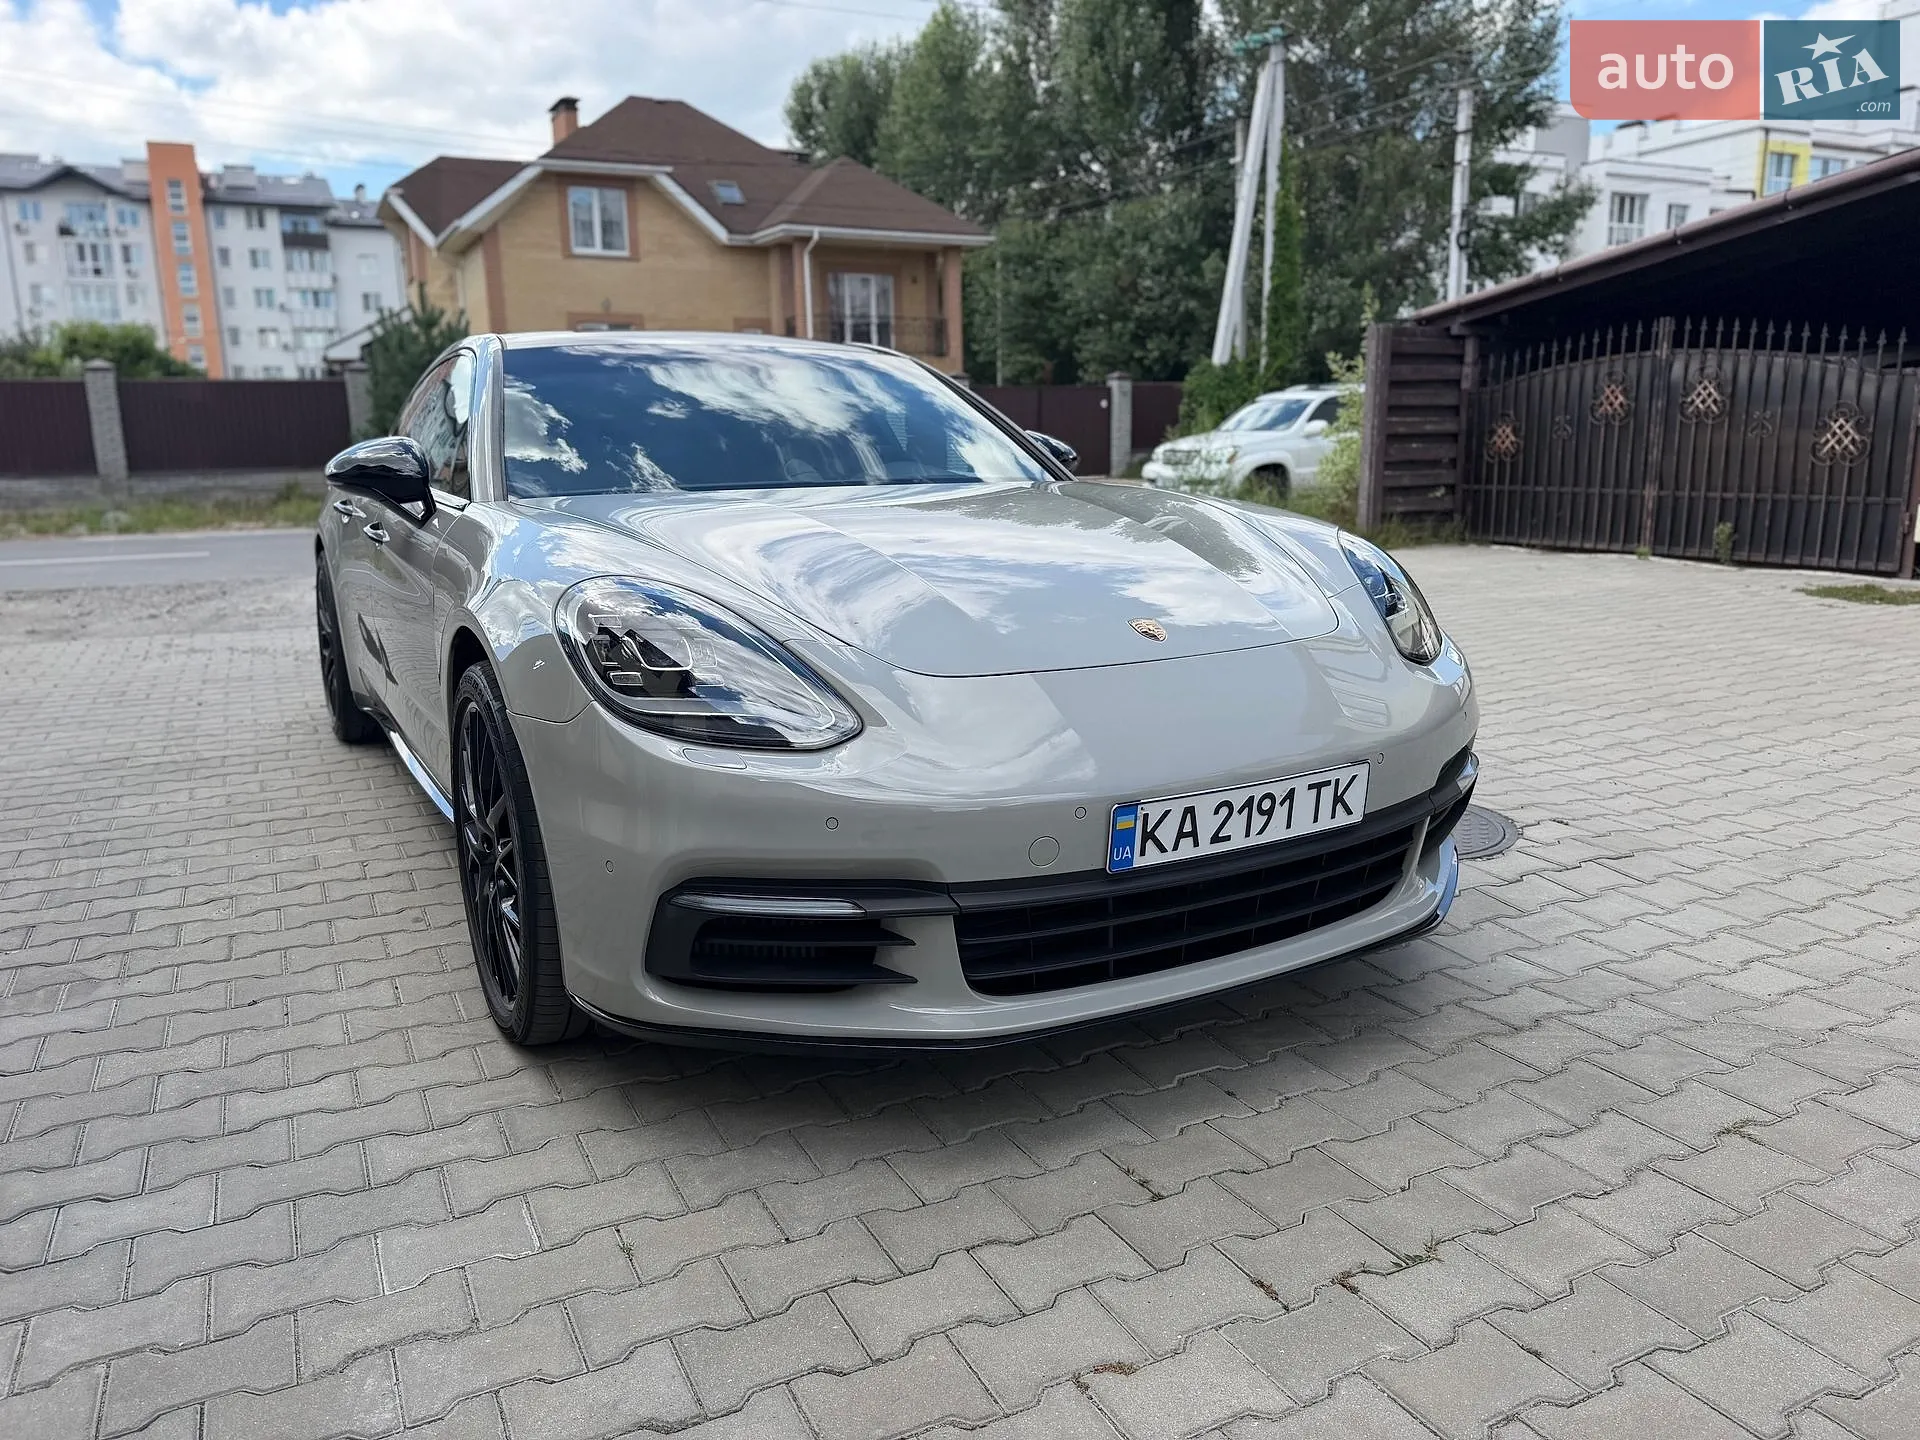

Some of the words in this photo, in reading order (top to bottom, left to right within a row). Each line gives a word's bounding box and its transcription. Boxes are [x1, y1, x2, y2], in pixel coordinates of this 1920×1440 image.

[1139, 805, 1200, 856] KA
[1209, 787, 1297, 845] 2191
[1307, 774, 1358, 824] TK
[1113, 845, 1132, 861] UA
